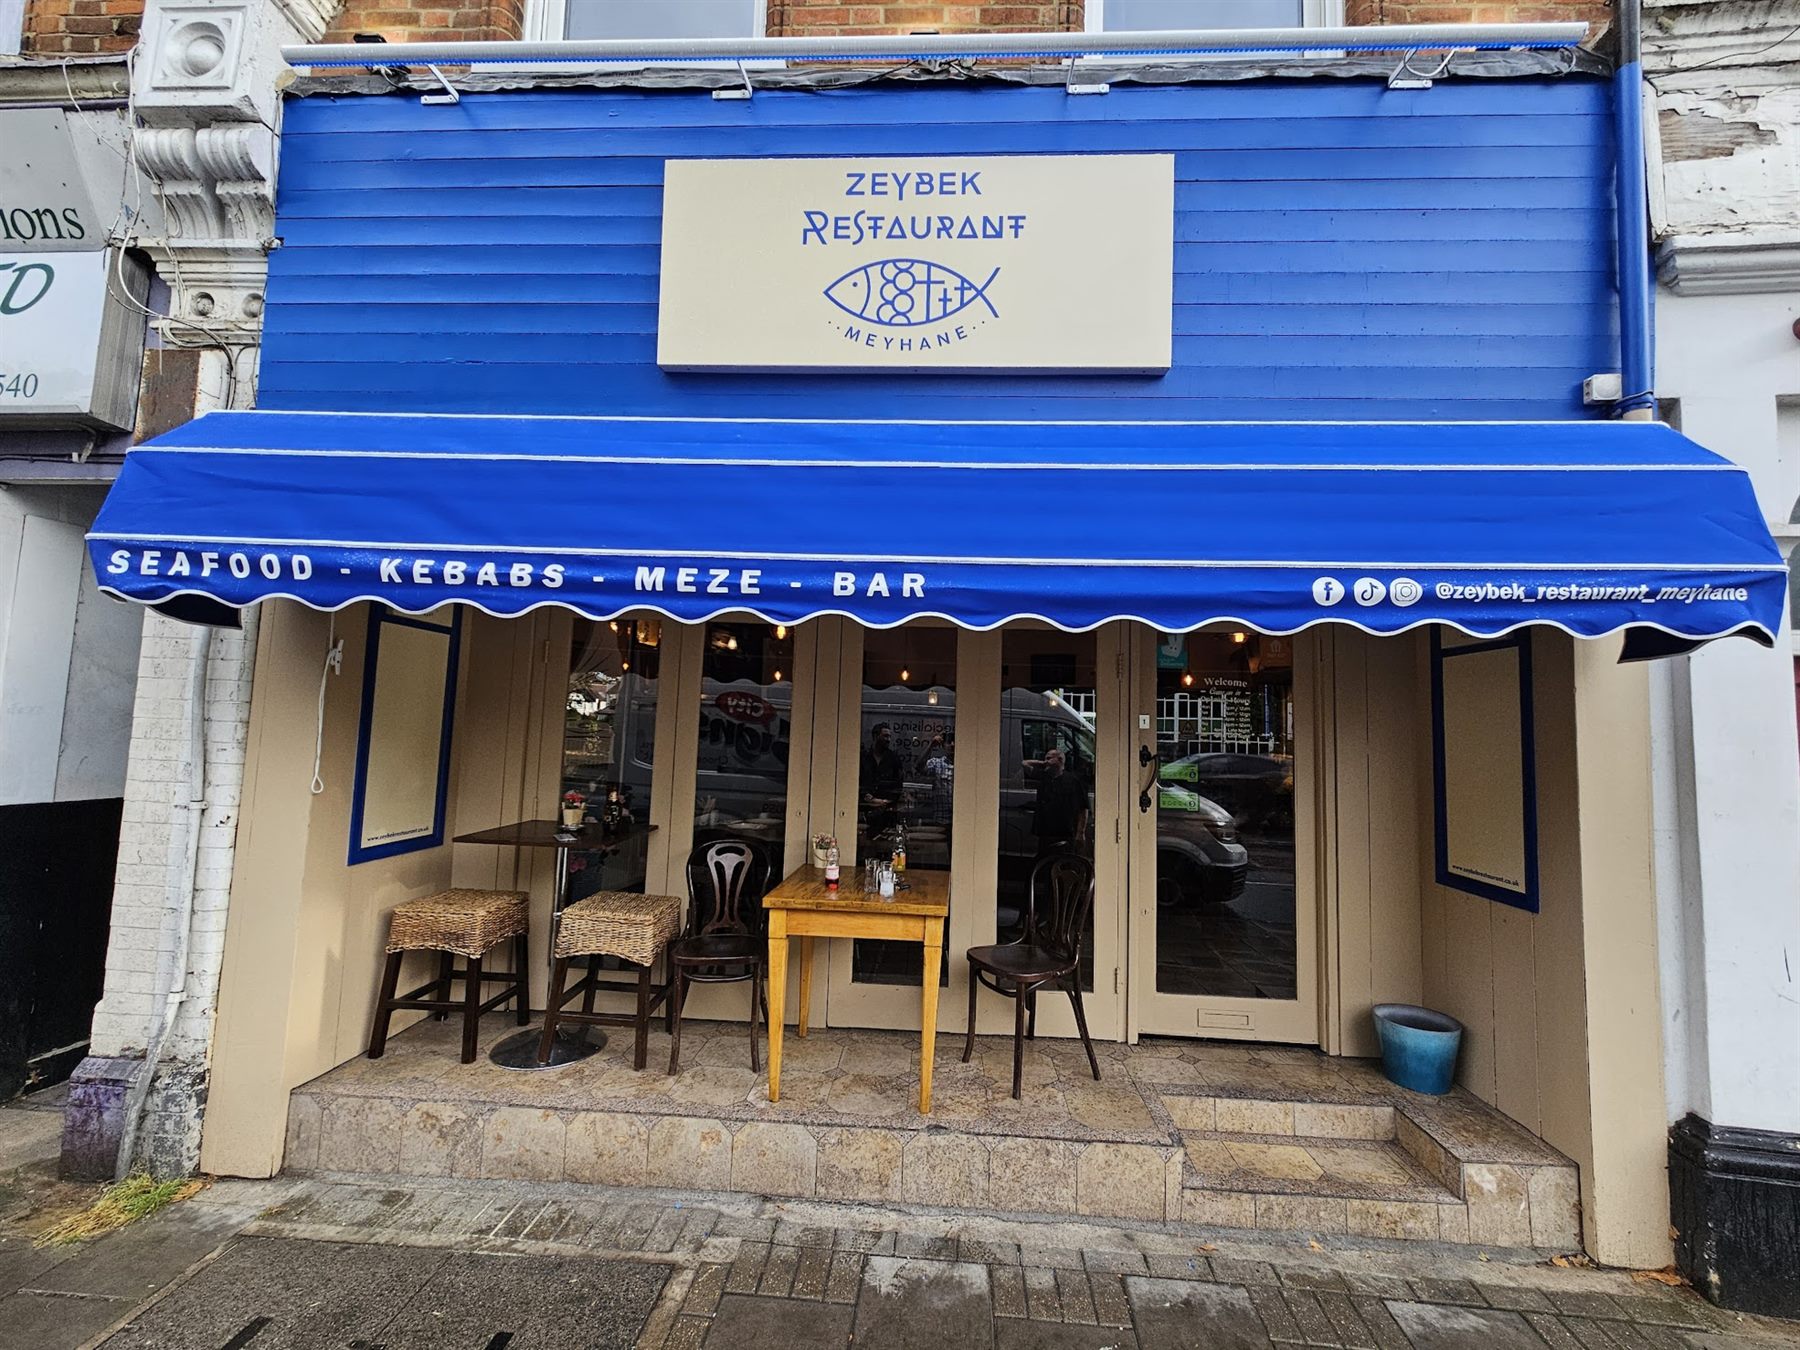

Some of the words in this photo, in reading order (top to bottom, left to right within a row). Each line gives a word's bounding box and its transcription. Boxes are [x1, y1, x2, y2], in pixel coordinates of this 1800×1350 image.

[846, 172, 983, 201] ZEYBEK
[803, 210, 1027, 245] RESTAURANT
[844, 325, 968, 352] MEYHANE
[106, 549, 313, 580] SEAFOOD
[379, 558, 566, 588] KEBABS
[634, 566, 763, 595] MEZE
[832, 571, 926, 598] BAR
[1435, 582, 1749, 604] @zeybek_restaurant_meyhane
[1203, 677, 1248, 688] Welcome
